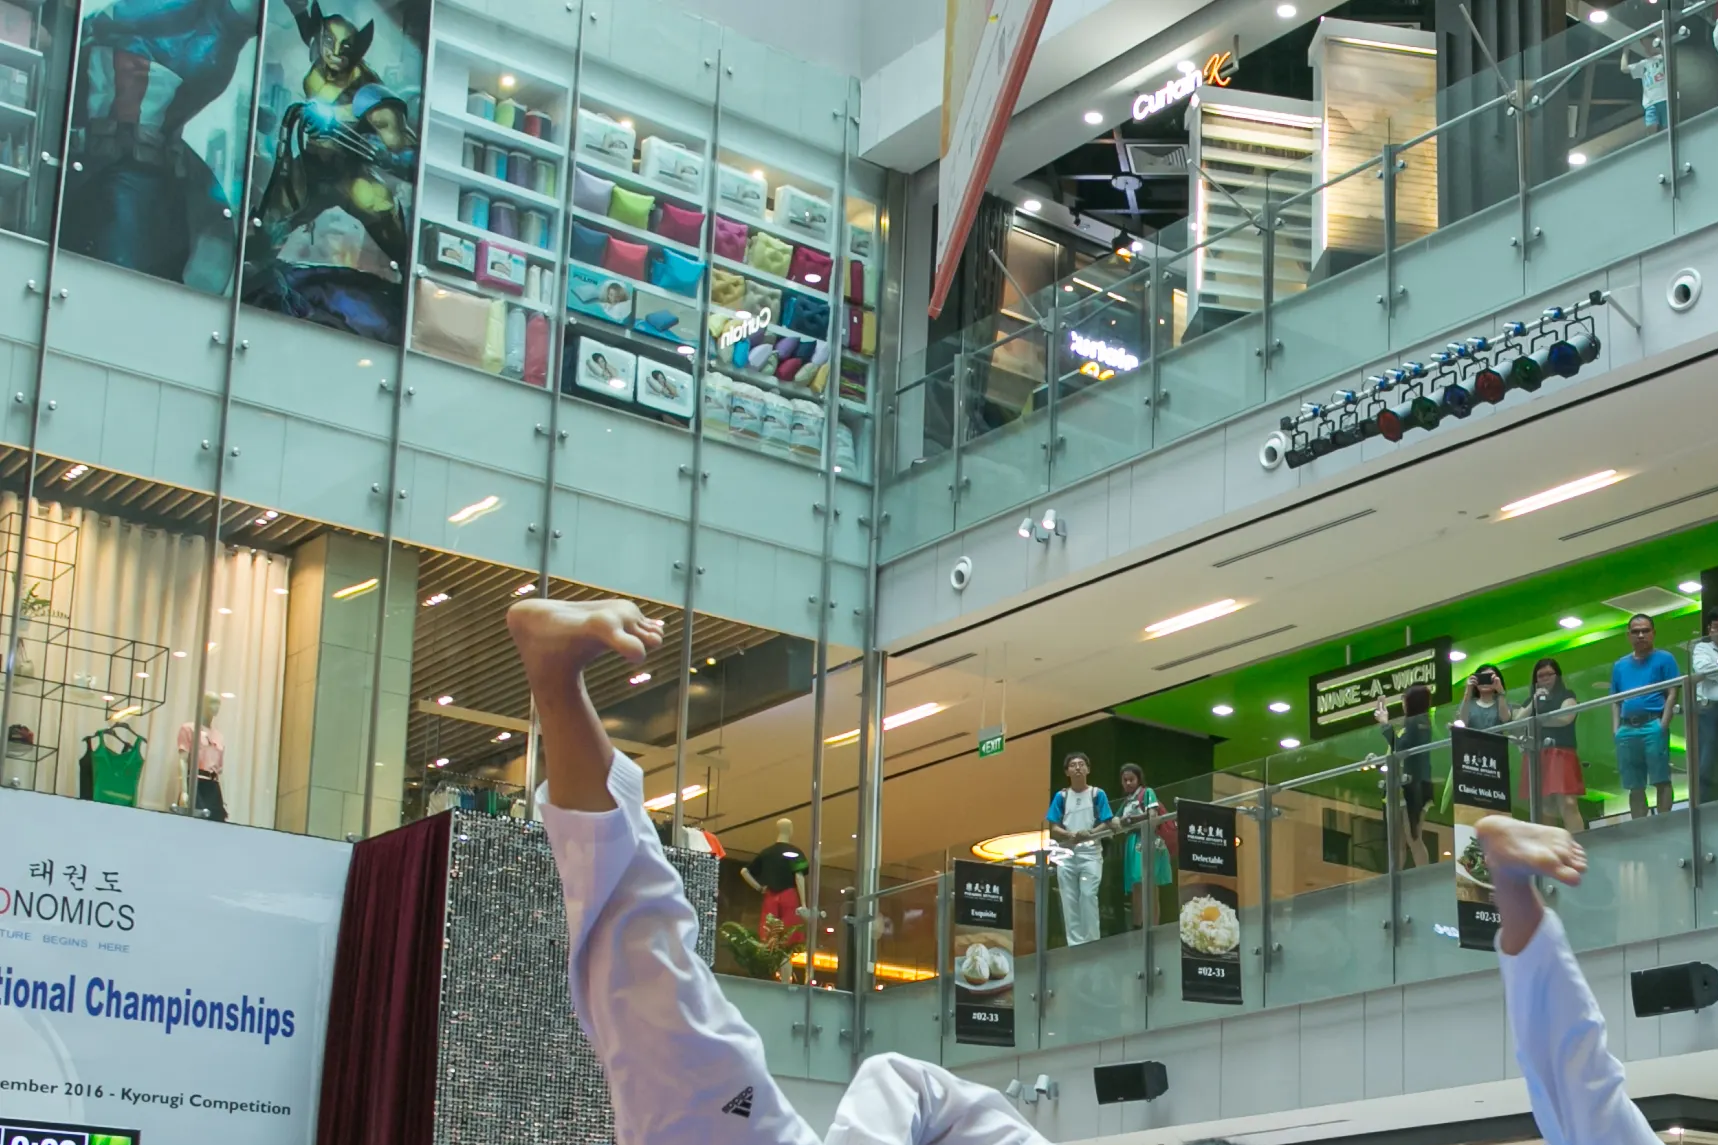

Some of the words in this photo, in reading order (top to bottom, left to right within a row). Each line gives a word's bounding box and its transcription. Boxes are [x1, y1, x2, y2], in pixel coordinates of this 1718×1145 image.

[1132, 69, 1203, 121] Curtain
[1458, 784, 1479, 796] Classic
[42, 934, 88, 948] BEGINS
[97, 942, 131, 954] HERE
[1197, 967, 1226, 978] #02-33
[85, 976, 295, 1045] Championships
[972, 1011, 1000, 1022] #02-33
[0, 1079, 58, 1095] ember
[64, 1082, 104, 1099] 2016
[121, 1087, 184, 1109] Kyorugi
[189, 1094, 292, 1116] Competition
